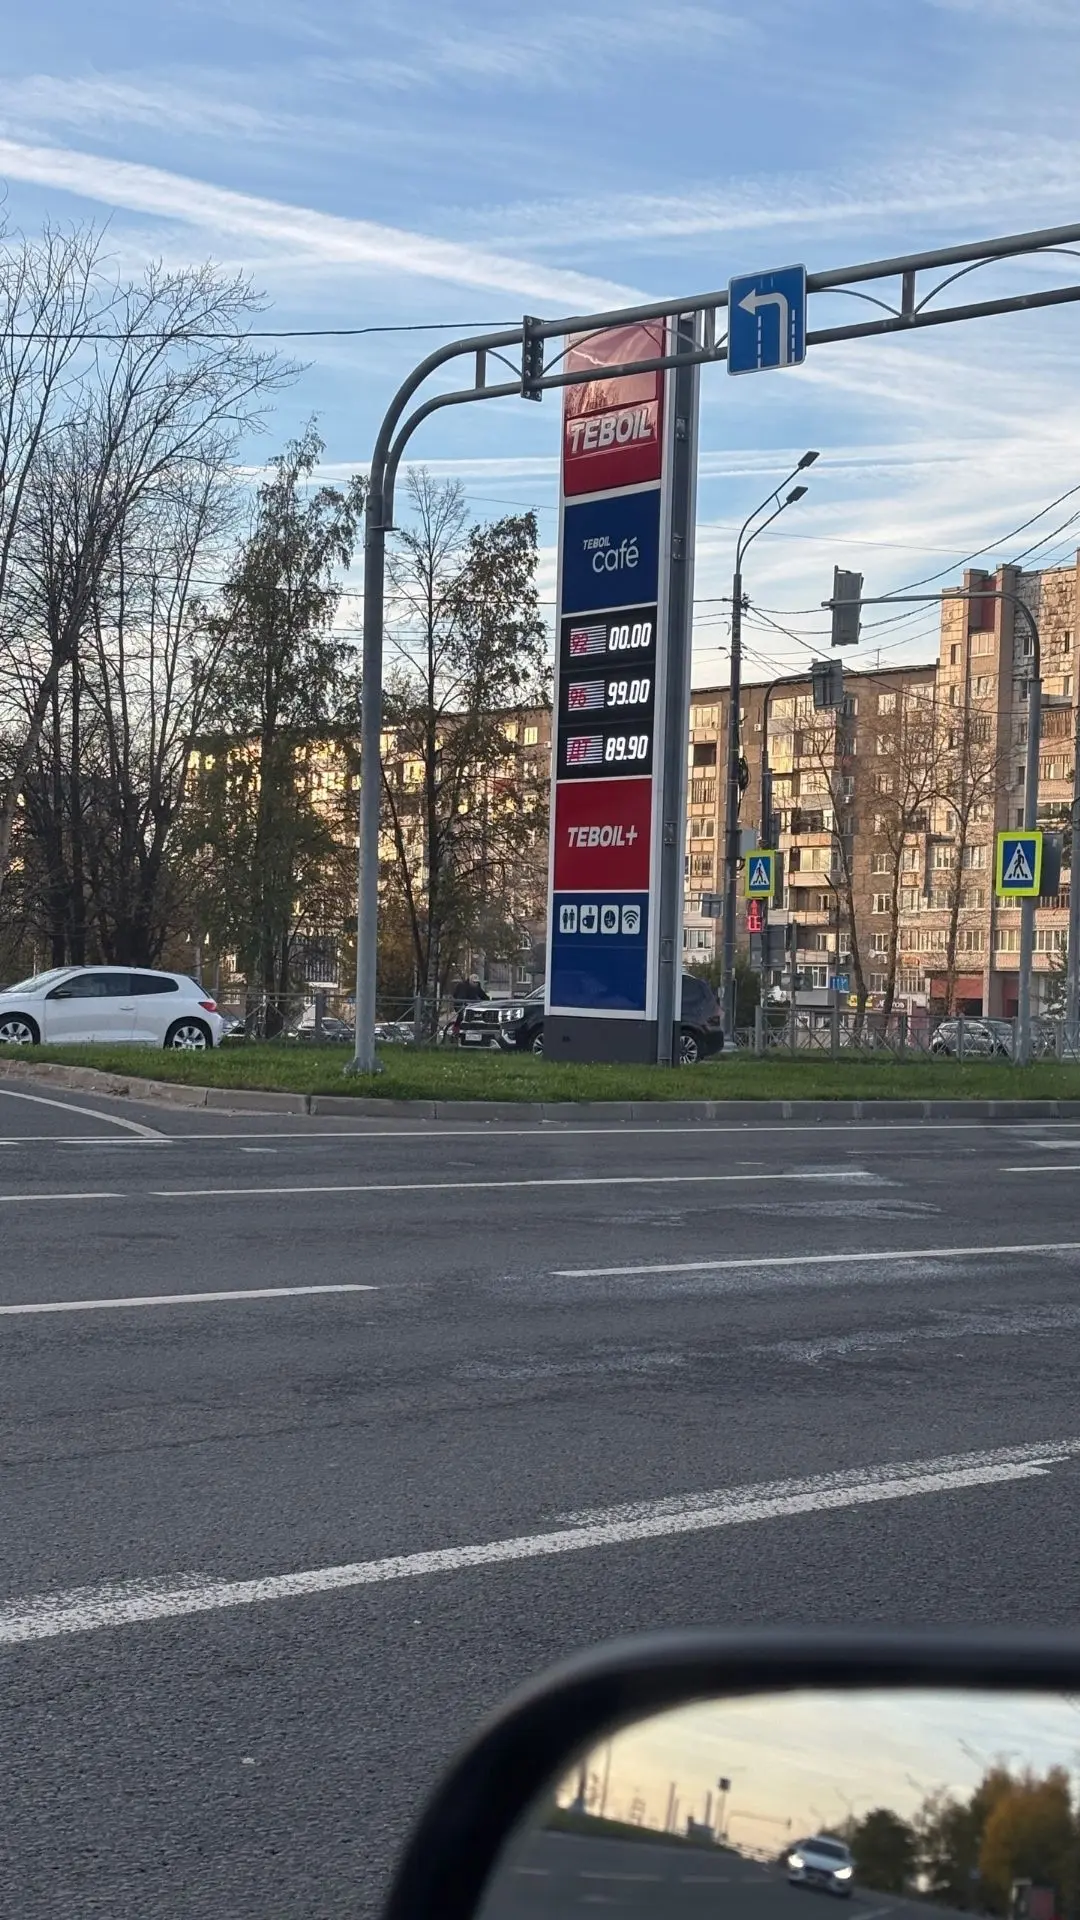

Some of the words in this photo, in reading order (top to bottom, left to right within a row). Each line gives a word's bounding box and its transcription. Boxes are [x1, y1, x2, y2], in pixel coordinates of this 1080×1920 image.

[571, 408, 651, 453] TEBOIL
[583, 536, 611, 550] TEBOIL
[592, 537, 639, 572] café
[608, 622, 652, 651] 00.00
[606, 679, 650, 706] 99.00
[605, 735, 648, 761] 89.90
[568, 825, 638, 847] TEBOIL+
